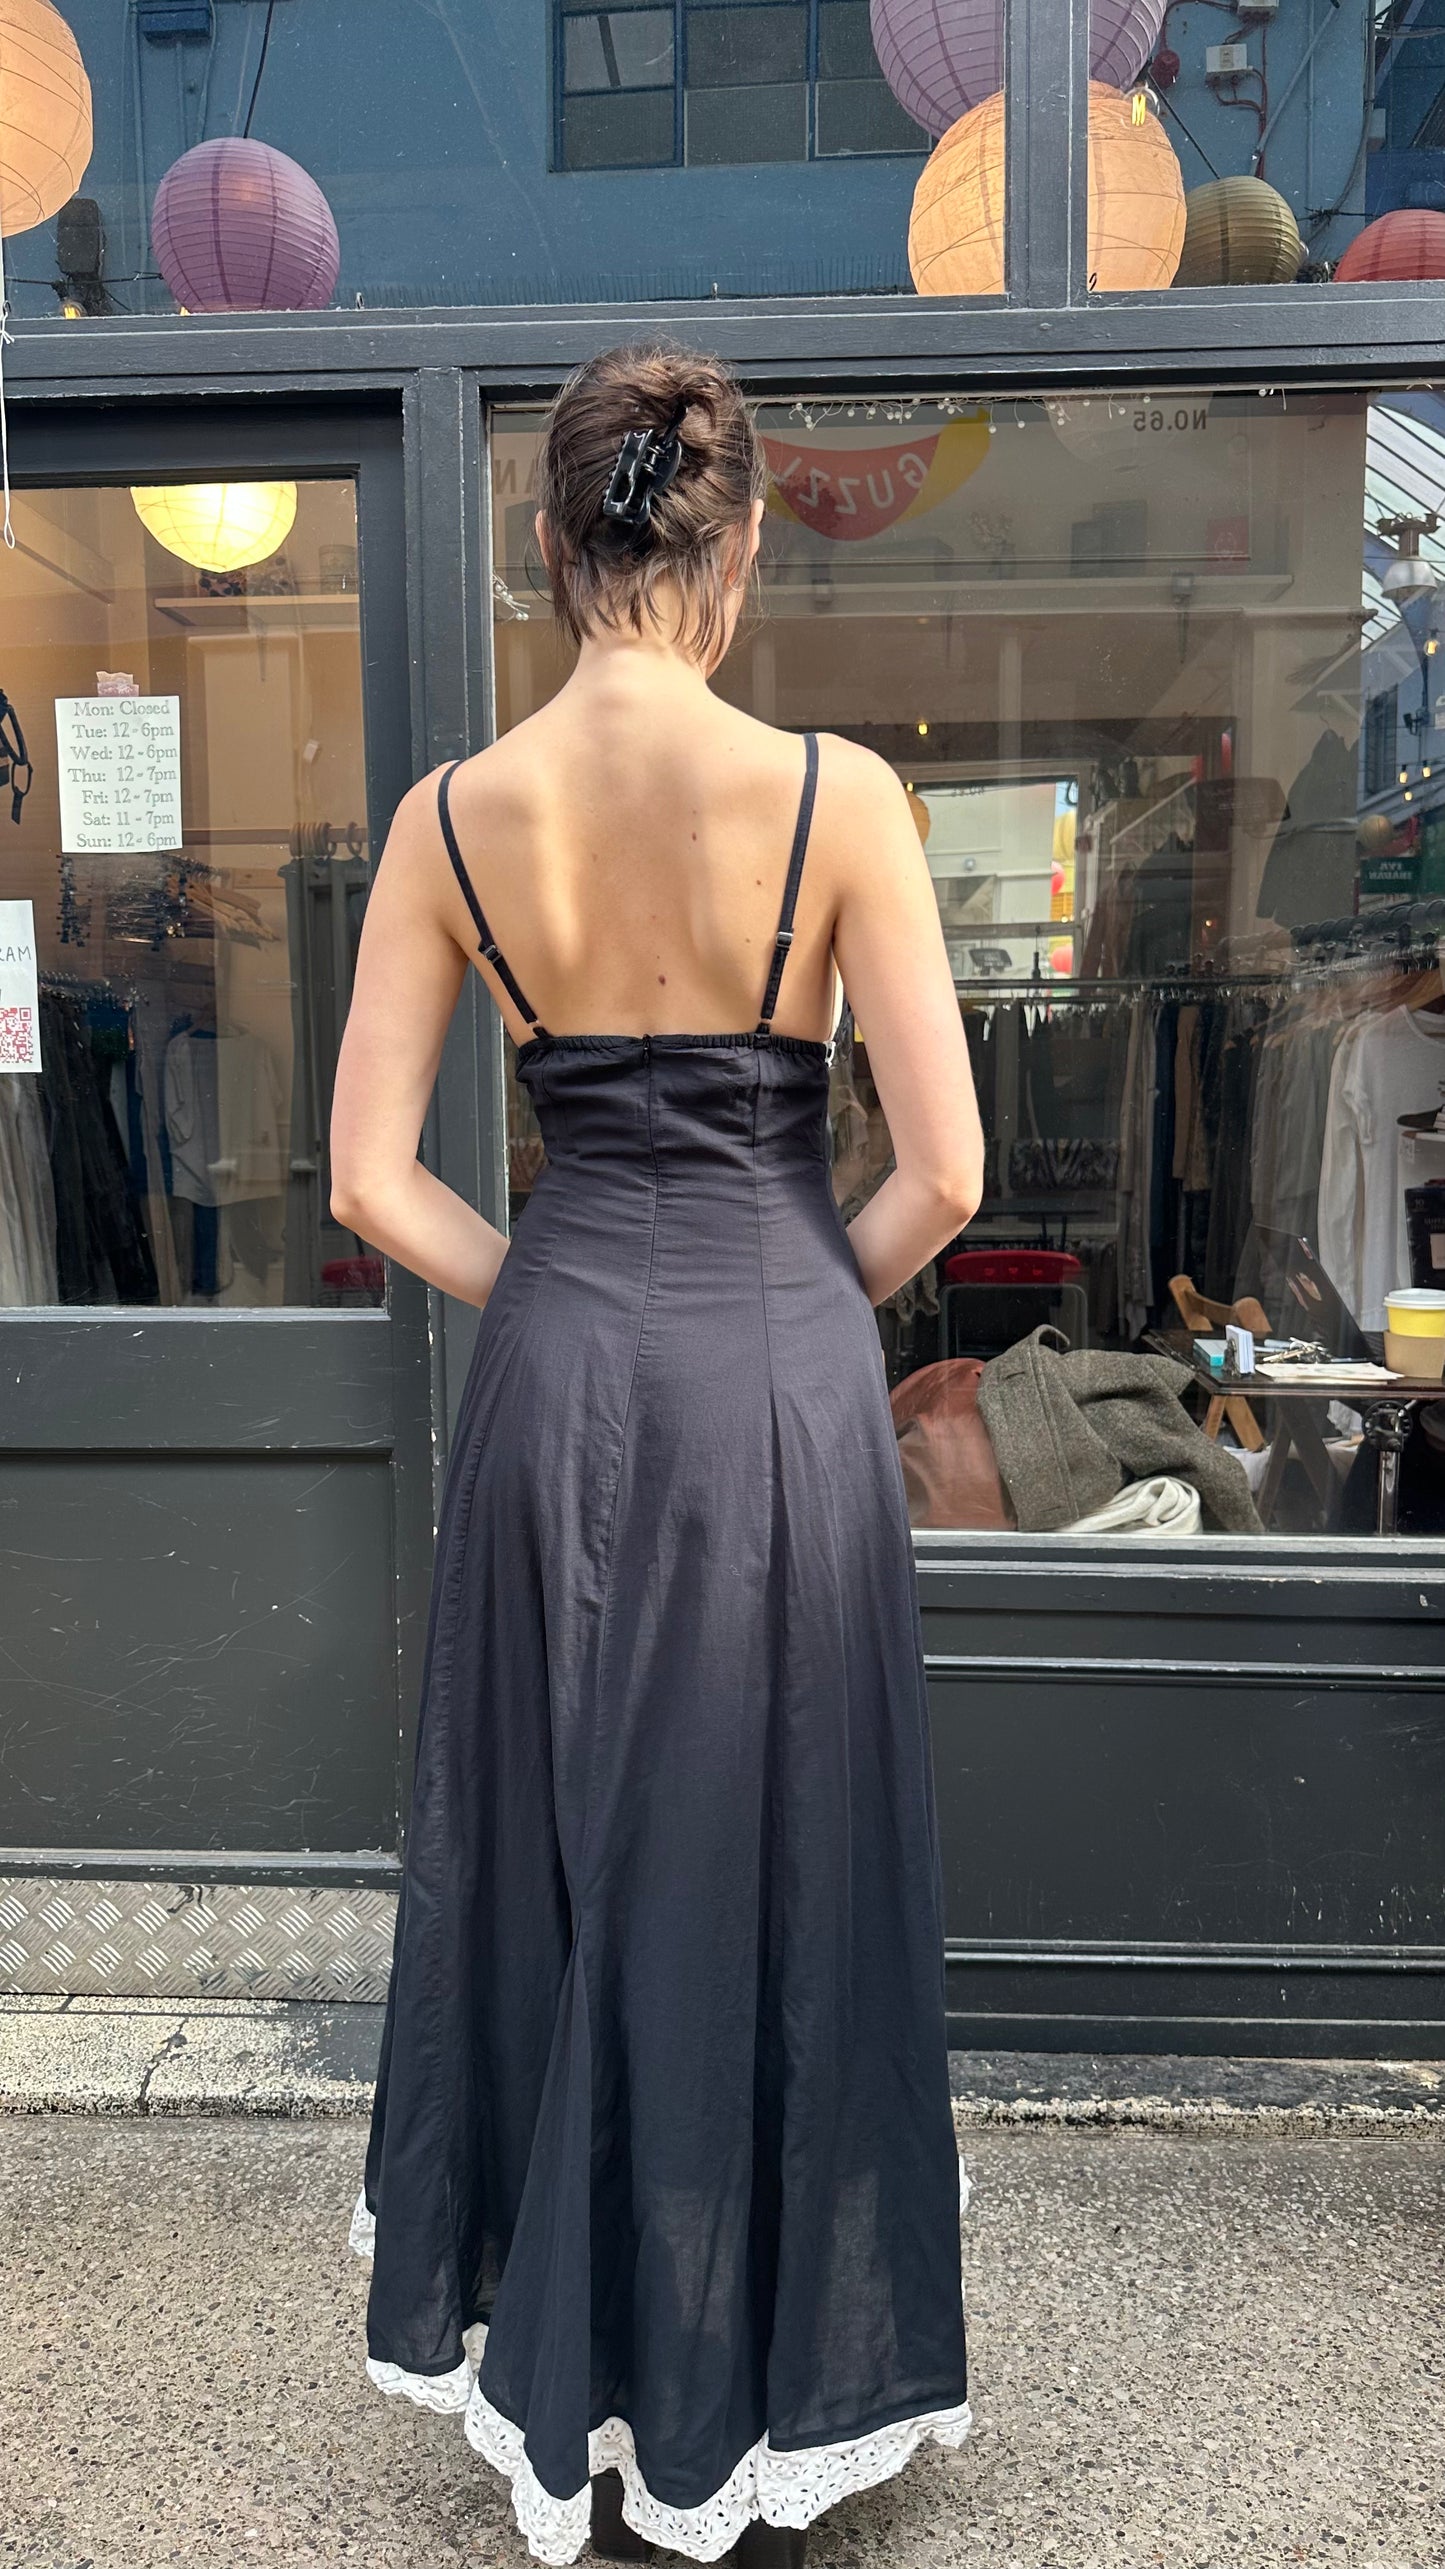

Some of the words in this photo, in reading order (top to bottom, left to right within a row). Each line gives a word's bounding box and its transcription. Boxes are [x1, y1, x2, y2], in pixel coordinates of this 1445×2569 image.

[74, 702, 114, 716] Mon:
[119, 700, 170, 715] Closed
[72, 724, 107, 738] Tue:
[70, 746, 112, 760] Wed:
[67, 768, 106, 782] Thu:
[82, 790, 108, 804] Fri:
[83, 811, 111, 826] Sat:
[77, 833, 111, 847] Sun:
